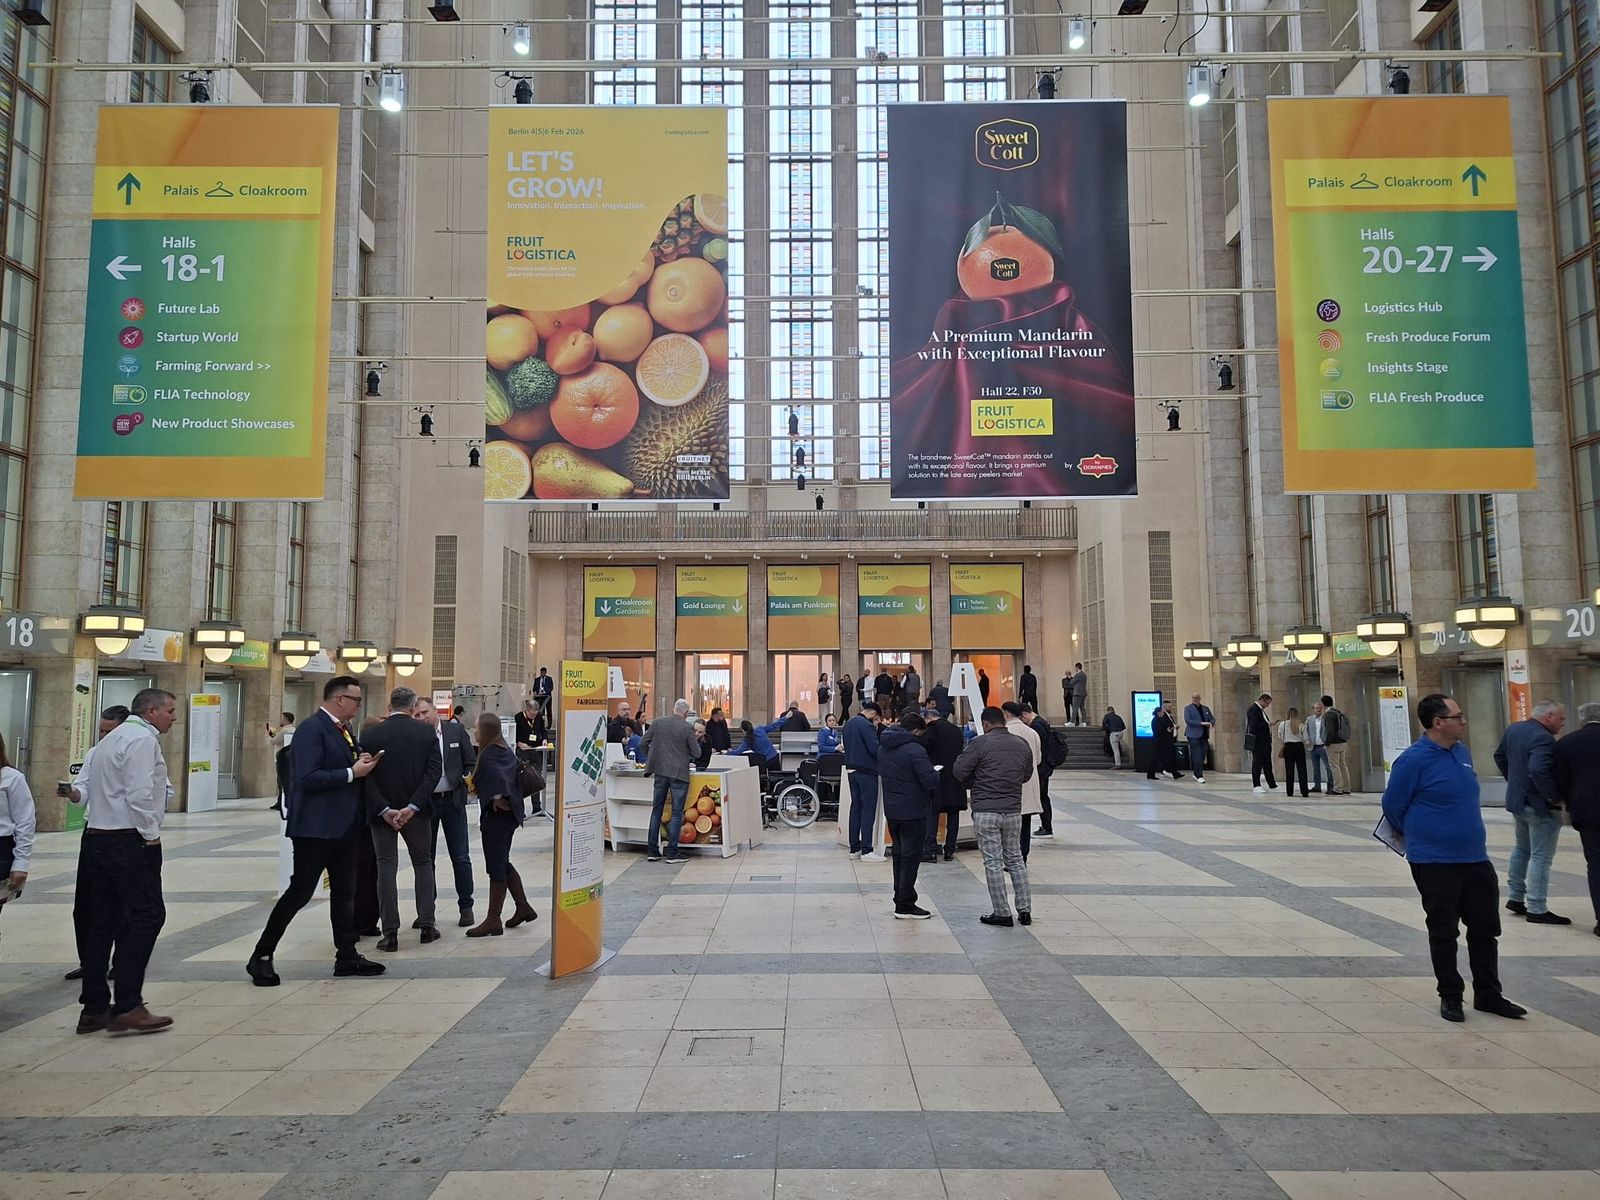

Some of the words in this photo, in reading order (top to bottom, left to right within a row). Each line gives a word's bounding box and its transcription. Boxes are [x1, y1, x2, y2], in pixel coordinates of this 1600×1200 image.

[508, 128, 529, 136] Berlin
[550, 128, 564, 136] Feb
[566, 128, 584, 136] 2026
[984, 129, 1029, 146] Sweet
[990, 144, 1024, 160] Cott
[1308, 176, 1344, 189] Palais
[1384, 174, 1453, 188] Cloakroom
[163, 184, 199, 198] Palais
[239, 184, 308, 198] Cloakroom
[507, 178, 604, 198] GROW!
[507, 202, 551, 210] Innovation.
[602, 202, 647, 211] Inspiration.
[1360, 228, 1394, 240] Halls
[162, 236, 196, 249] Halls
[507, 236, 544, 246] FRUIT
[507, 250, 576, 260] LOGISTICA
[1362, 246, 1454, 274] 20-27
[161, 254, 225, 282] 18-1
[993, 262, 1016, 270] Sweet
[158, 303, 197, 315] Future
[199, 303, 220, 315] Lab
[1364, 302, 1416, 314] Logistics
[1418, 301, 1443, 312] Hub
[156, 331, 200, 346] Startup
[202, 331, 239, 343] World
[928, 331, 940, 343] A
[944, 330, 1012, 343] Premium
[1018, 328, 1093, 342] Mandarin
[1366, 332, 1398, 344] Fresh
[1401, 331, 1450, 343] Produce
[1452, 331, 1491, 342] Forum
[917, 347, 952, 360] with
[957, 346, 1044, 362] Exceptional
[1048, 346, 1106, 358] Flavour
[156, 360, 202, 374] Farming
[205, 360, 254, 372] Forward
[1368, 362, 1414, 374] Insights
[1416, 362, 1448, 375] Stage
[154, 388, 180, 400] FLIA
[182, 388, 251, 403] Technology
[981, 386, 1003, 396] Hall
[1004, 386, 1020, 398] 22,
[1022, 386, 1042, 396] F50
[1370, 392, 1397, 403] FLIA
[1400, 392, 1432, 403] Fresh
[1435, 391, 1484, 402] Produce
[977, 406, 1014, 416] FRUIT
[152, 418, 179, 430] New
[182, 418, 228, 430] Product
[230, 418, 296, 430] Showcases
[977, 418, 1046, 430] LOGISTICA
[930, 462, 964, 471] exceptional
[966, 462, 988, 470] flavour.
[994, 462, 1013, 470] brings
[1020, 462, 1047, 470] premium
[1064, 462, 1072, 470] by
[978, 471, 1001, 480] peelers
[701, 602, 726, 610] Lounge
[1566, 606, 1596, 638] 20
[6, 616, 34, 648] 18
[240, 648, 258, 659] Lounge
[1344, 643, 1357, 652] Gold
[566, 670, 583, 678] FRUIT
[566, 680, 596, 688] LOGISTICA
